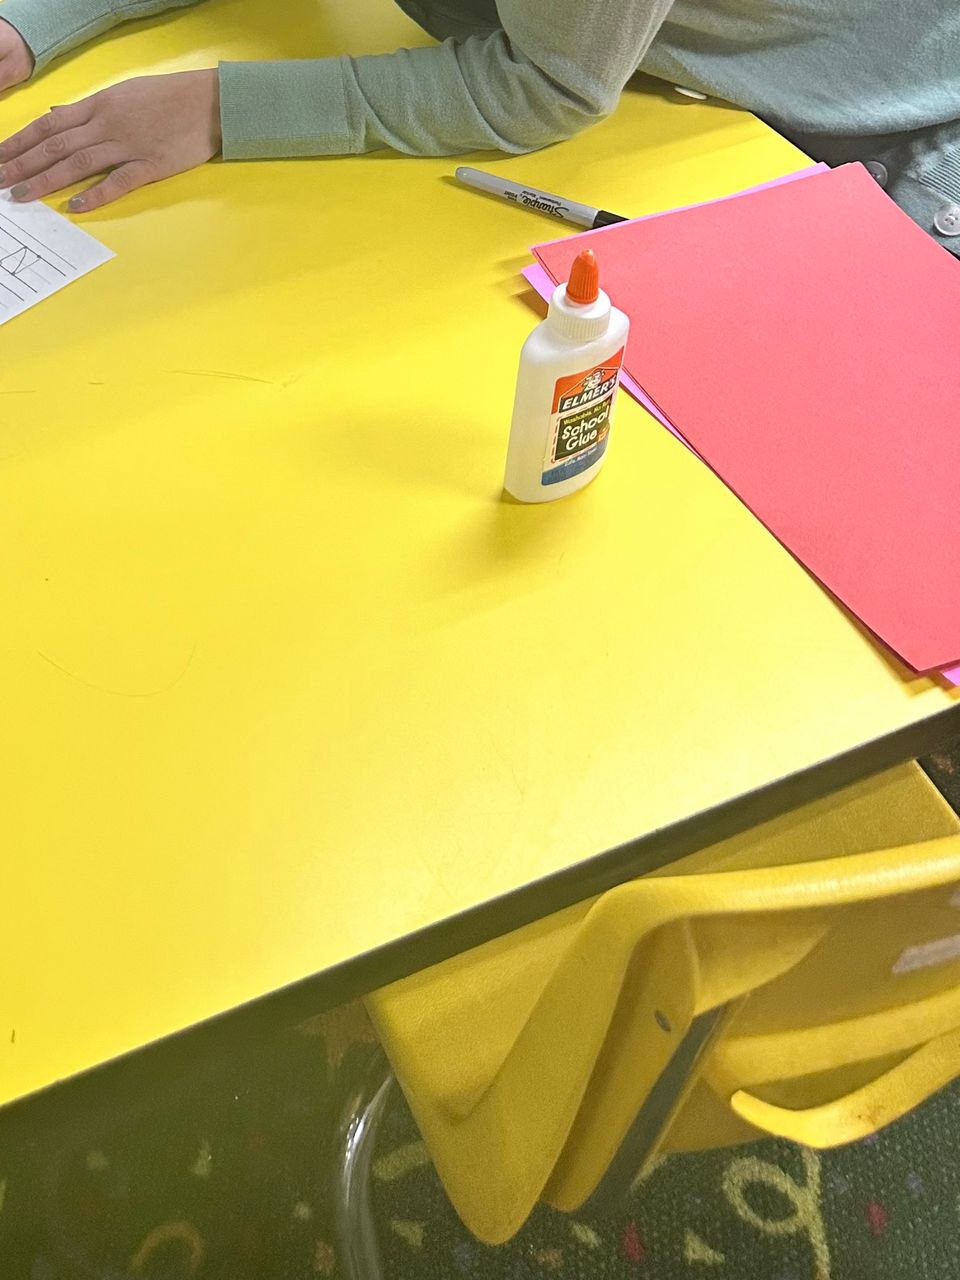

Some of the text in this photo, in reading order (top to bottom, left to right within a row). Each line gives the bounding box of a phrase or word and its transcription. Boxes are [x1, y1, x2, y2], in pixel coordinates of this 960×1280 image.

[521, 194, 570, 219] Sharpie
[561, 405, 610, 440] School
[565, 428, 598, 451] Glue
